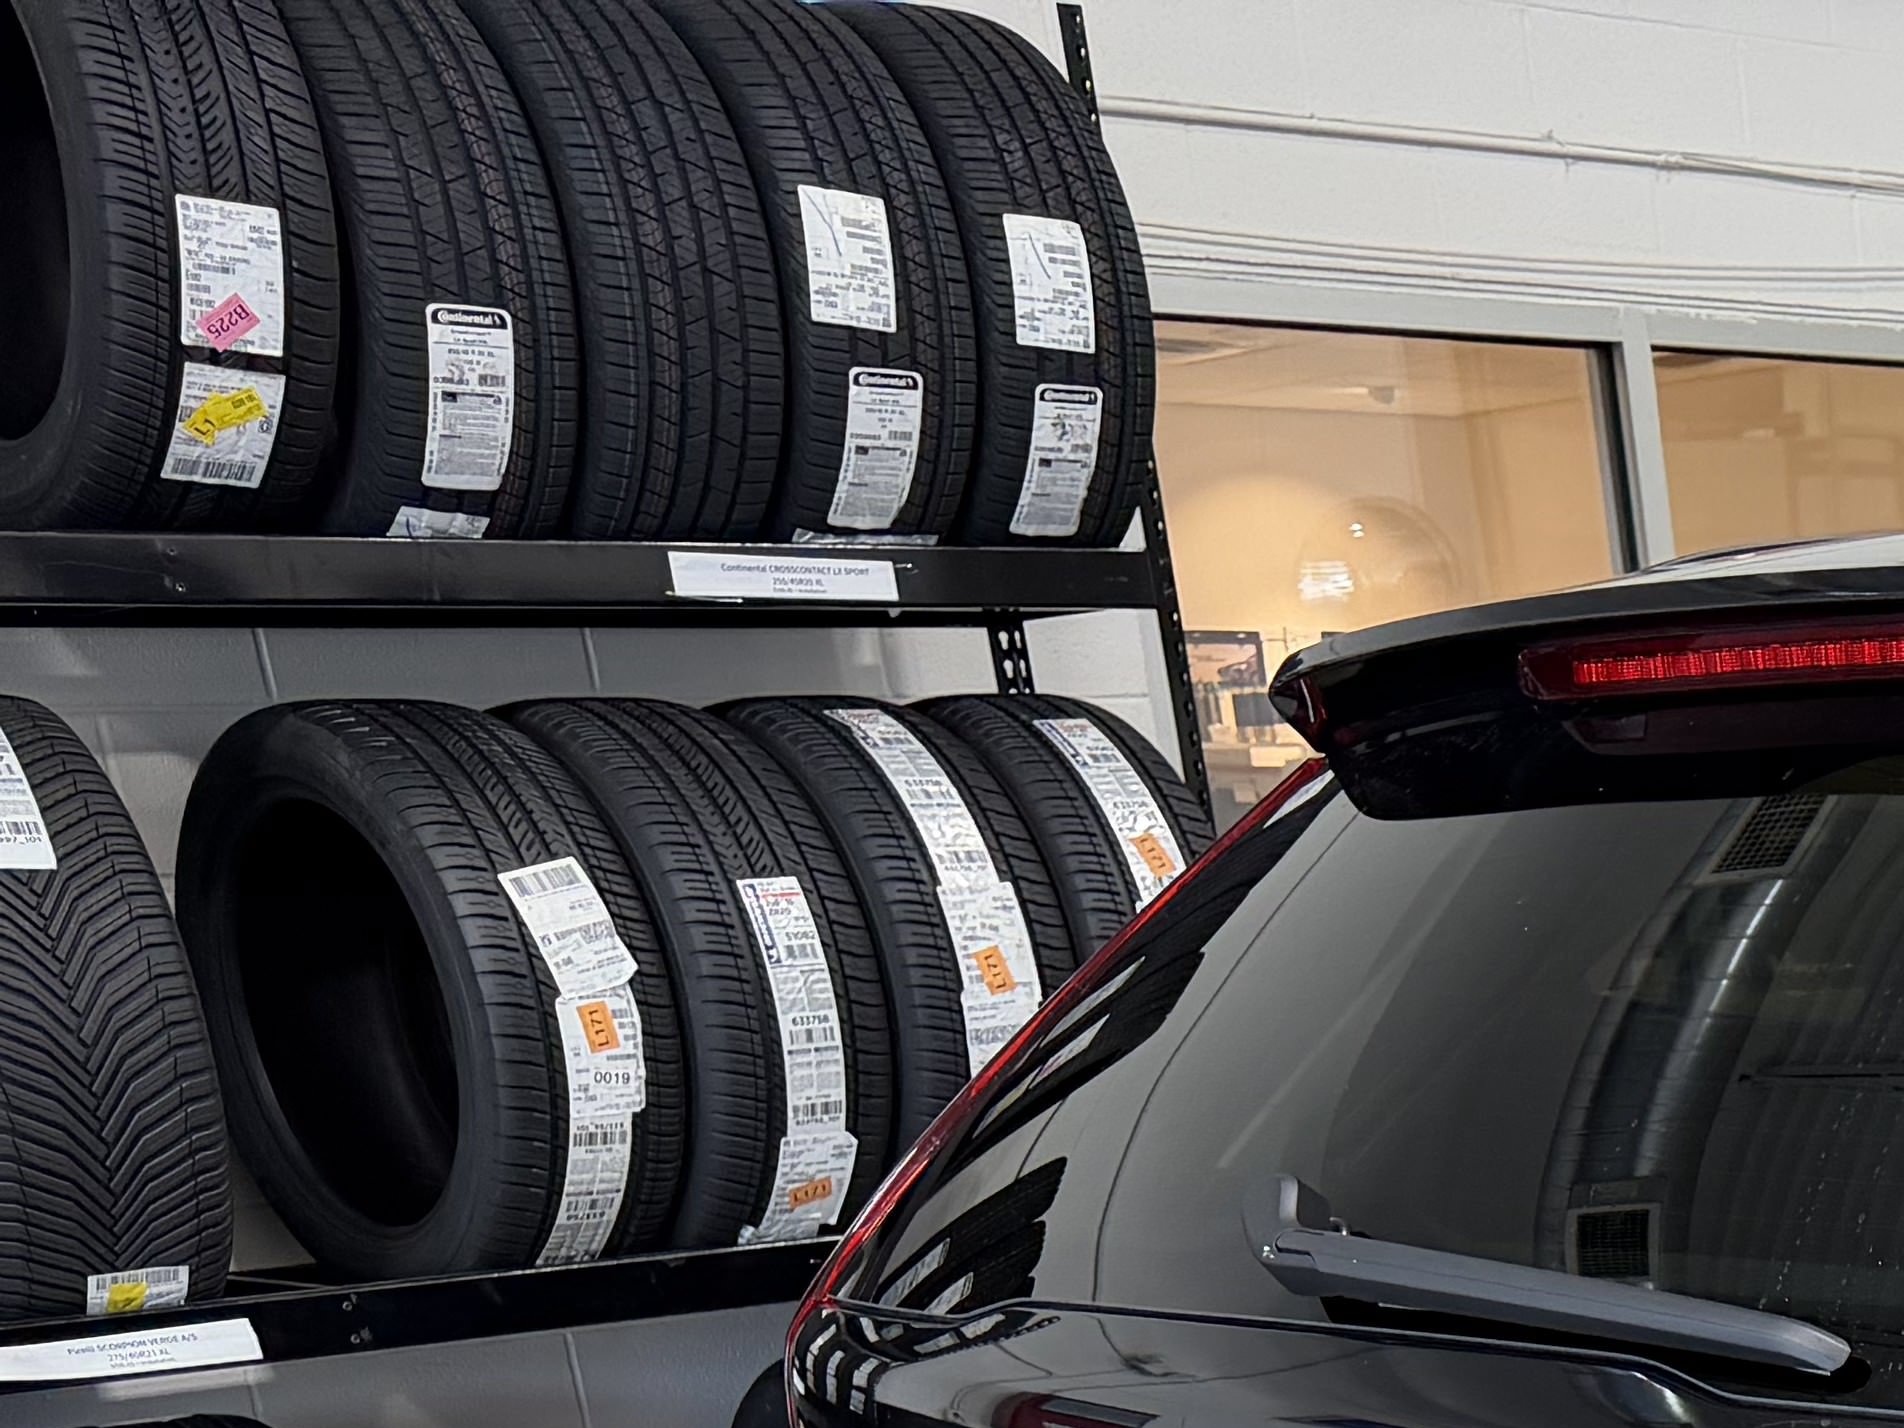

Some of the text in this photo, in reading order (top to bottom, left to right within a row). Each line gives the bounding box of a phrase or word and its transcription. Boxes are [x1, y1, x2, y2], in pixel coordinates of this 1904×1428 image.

[207, 303, 250, 339] B225
[721, 563, 767, 573] Continental
[844, 566, 870, 577] SPORT
[588, 1009, 610, 1047] L171
